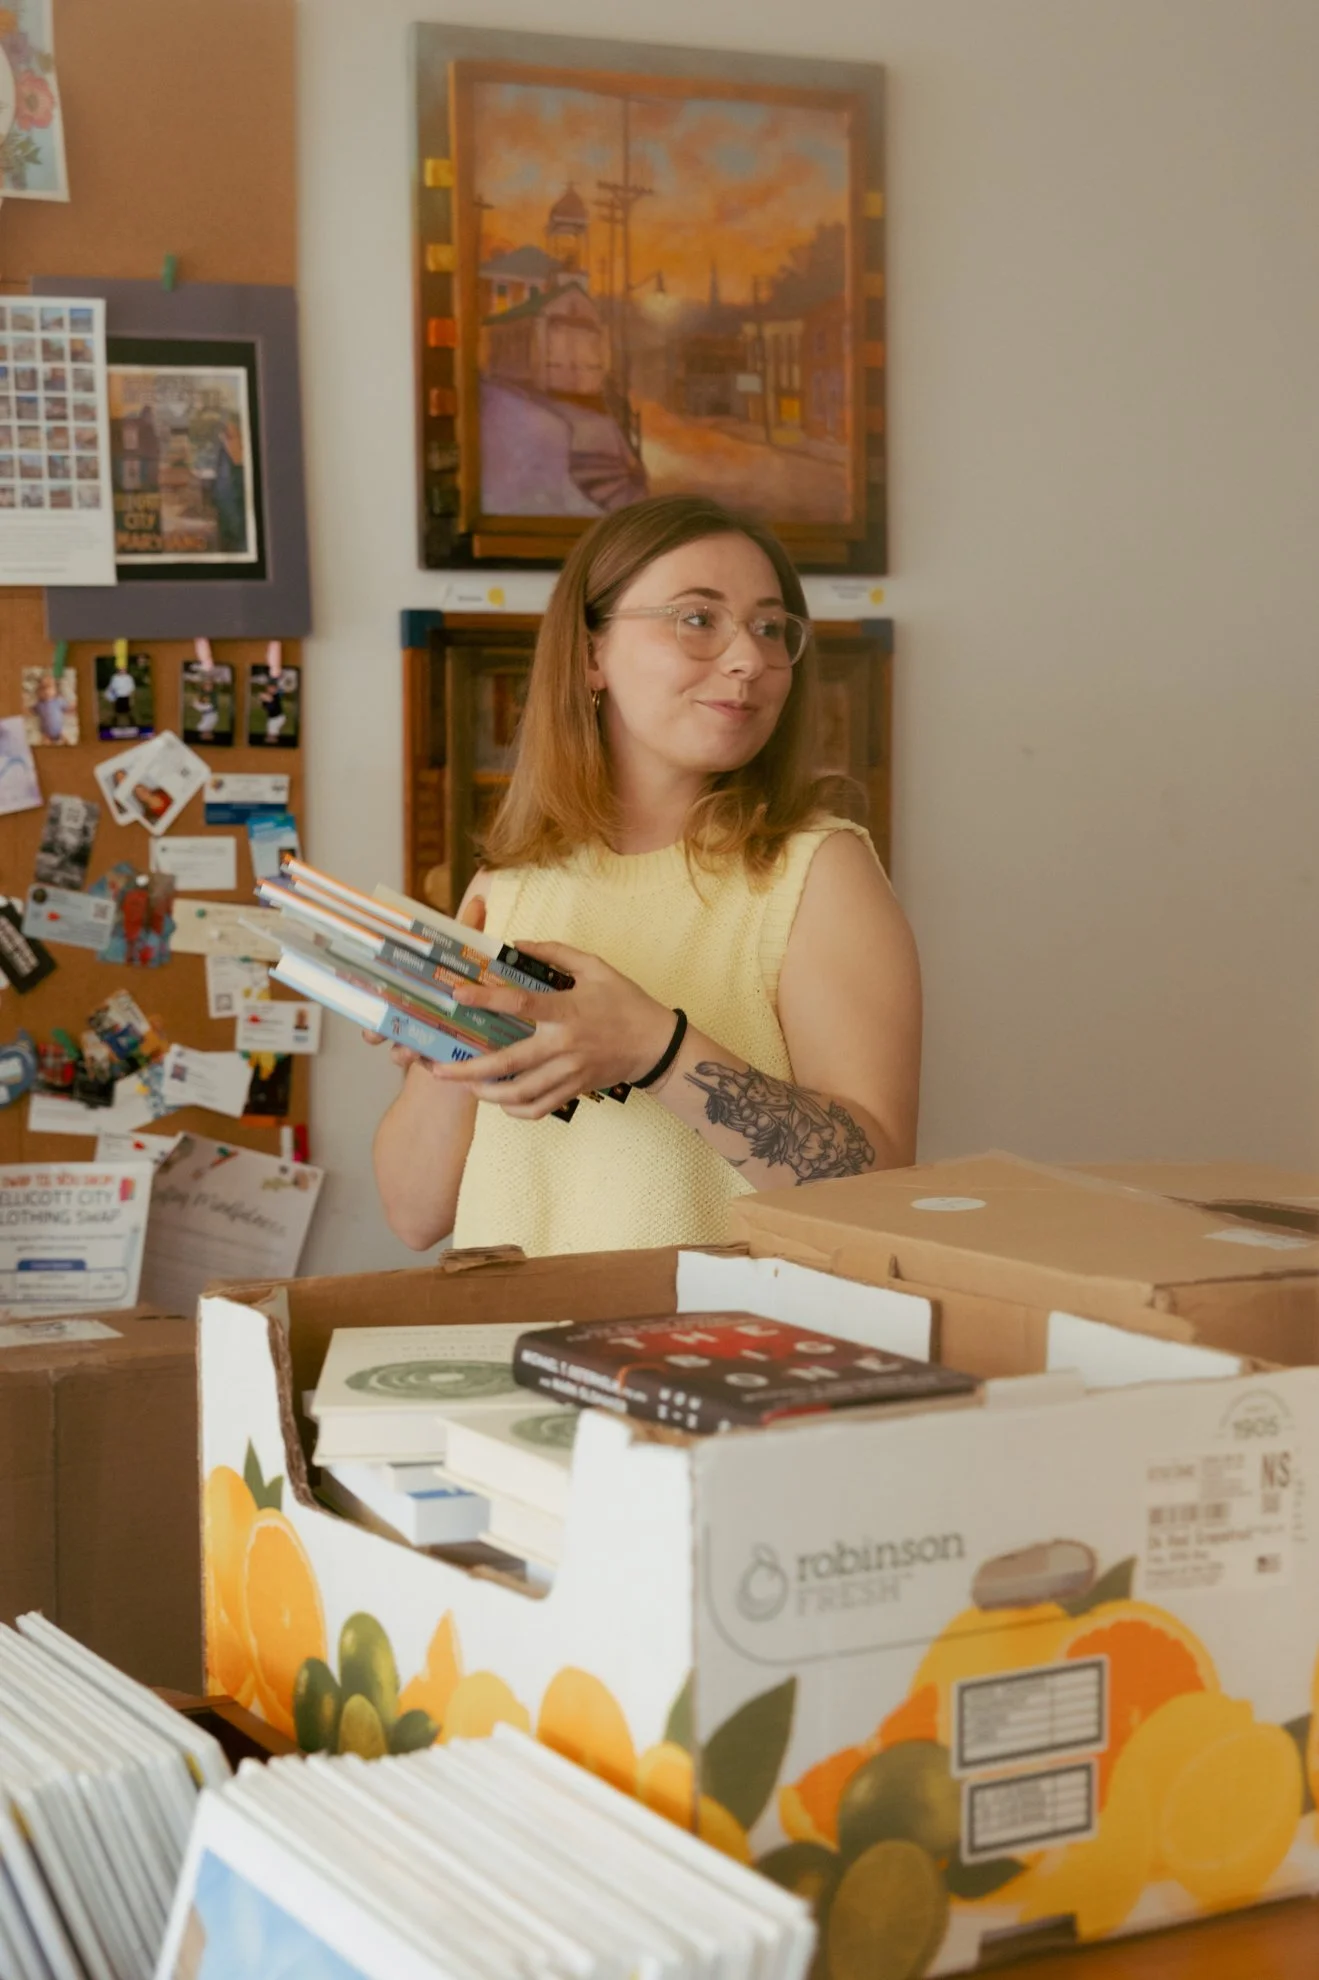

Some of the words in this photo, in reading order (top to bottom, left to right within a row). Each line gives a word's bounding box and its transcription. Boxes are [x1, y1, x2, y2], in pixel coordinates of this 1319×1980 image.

[500, 966, 526, 986] TODAY
[0, 1210, 71, 1226] LOTHING
[1261, 1451, 1291, 1489] NS
[797, 1532, 965, 1583] robinson
[797, 1575, 901, 1617] FRESH
